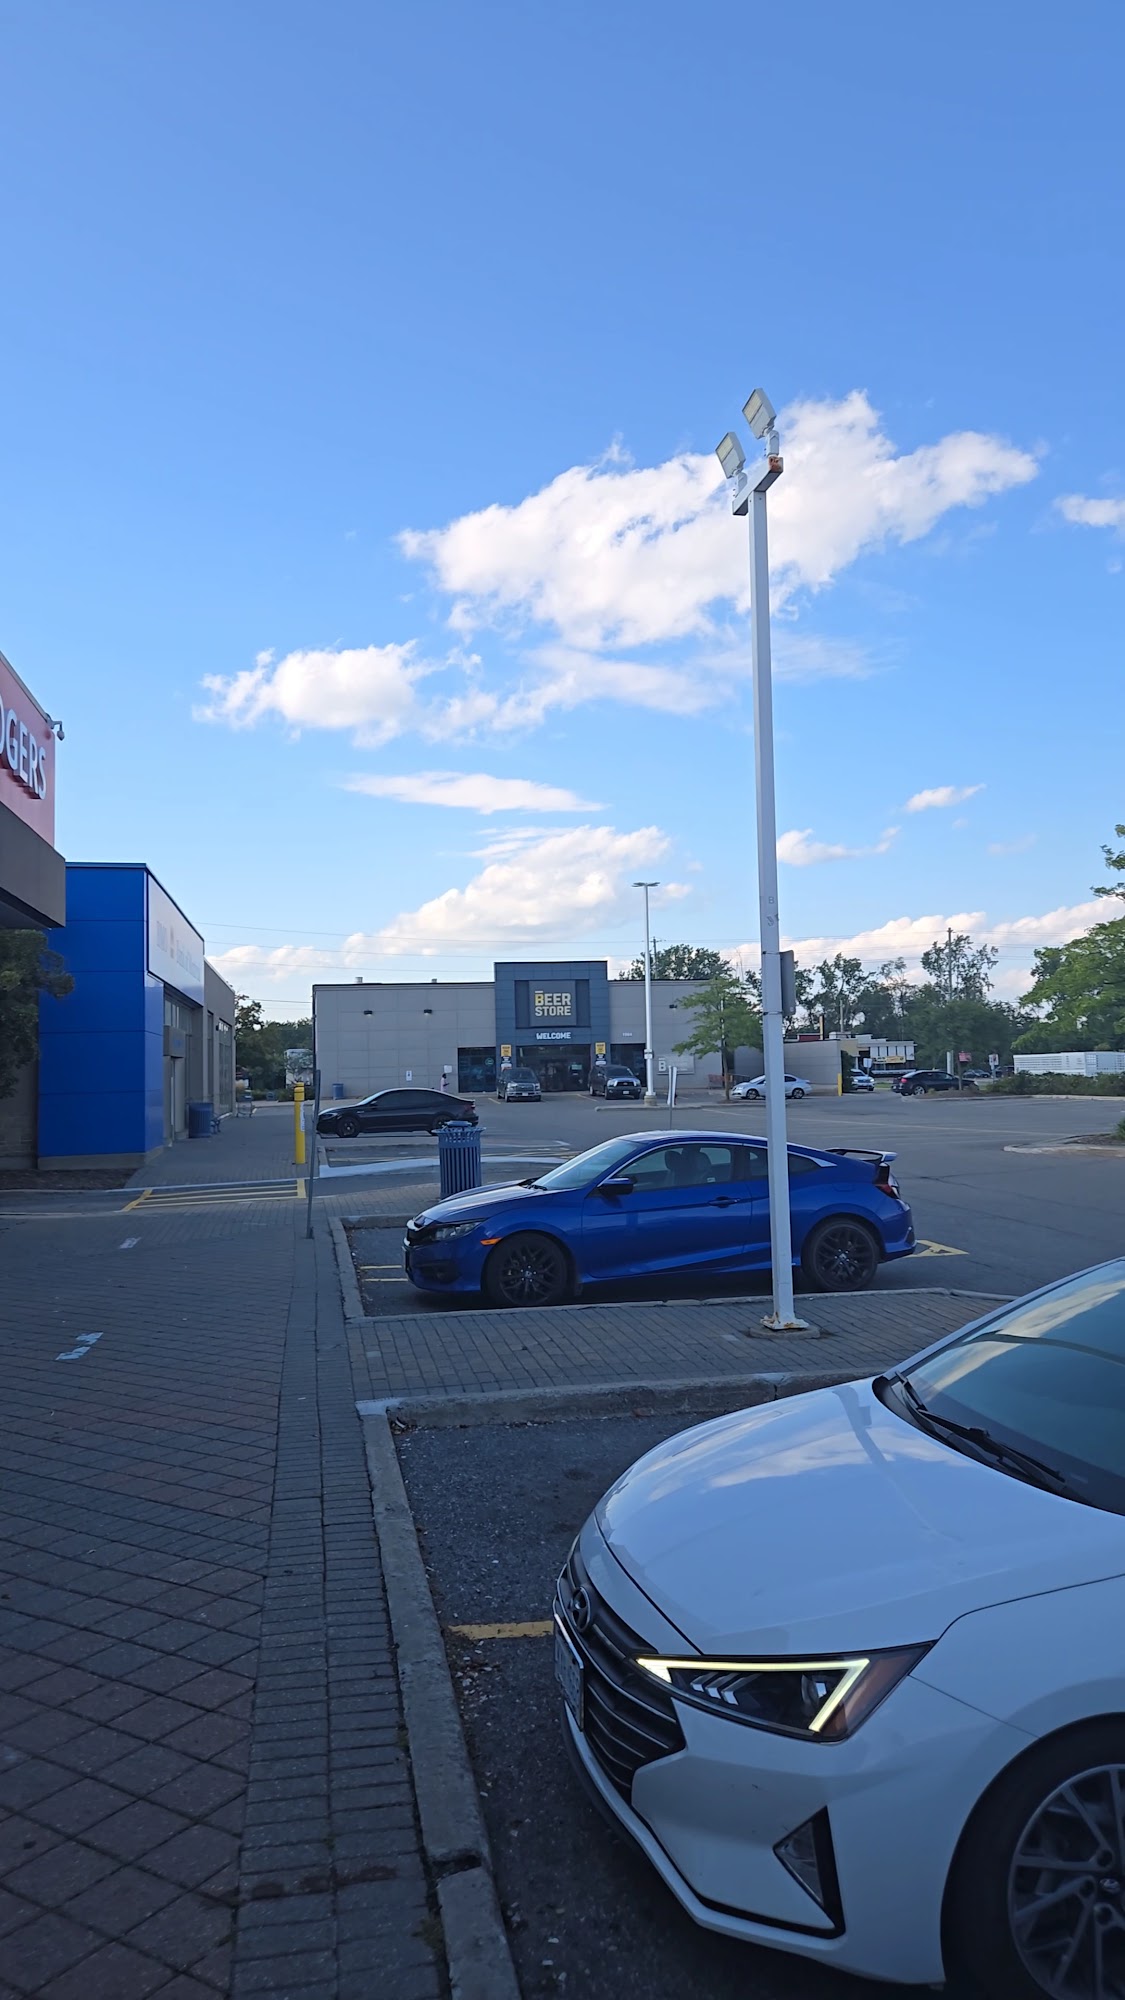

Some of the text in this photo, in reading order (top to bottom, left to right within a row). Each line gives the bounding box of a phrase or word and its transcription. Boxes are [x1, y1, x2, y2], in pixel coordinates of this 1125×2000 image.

[535, 991, 572, 1006] BEER
[535, 1005, 572, 1017] STORE
[536, 1032, 572, 1040] WELCOME
